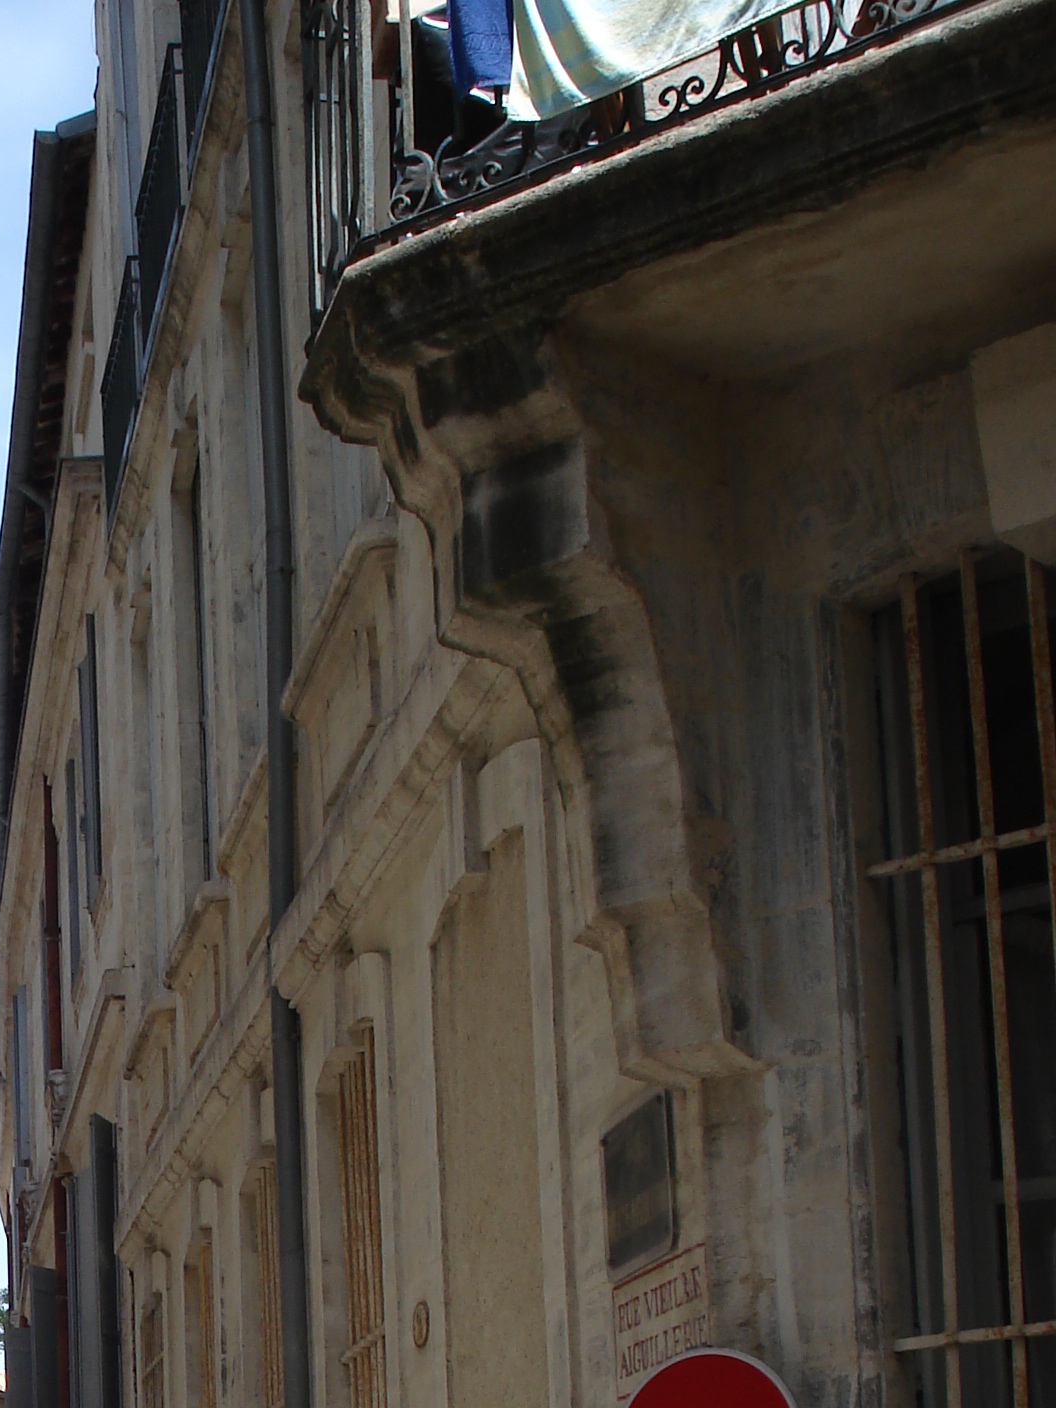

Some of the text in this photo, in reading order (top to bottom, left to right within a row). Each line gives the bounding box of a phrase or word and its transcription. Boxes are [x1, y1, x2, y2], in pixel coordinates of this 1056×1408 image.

[617, 1266, 704, 1334] RUE VIEILLE
[619, 1314, 709, 1380] AIGUILLERIE
